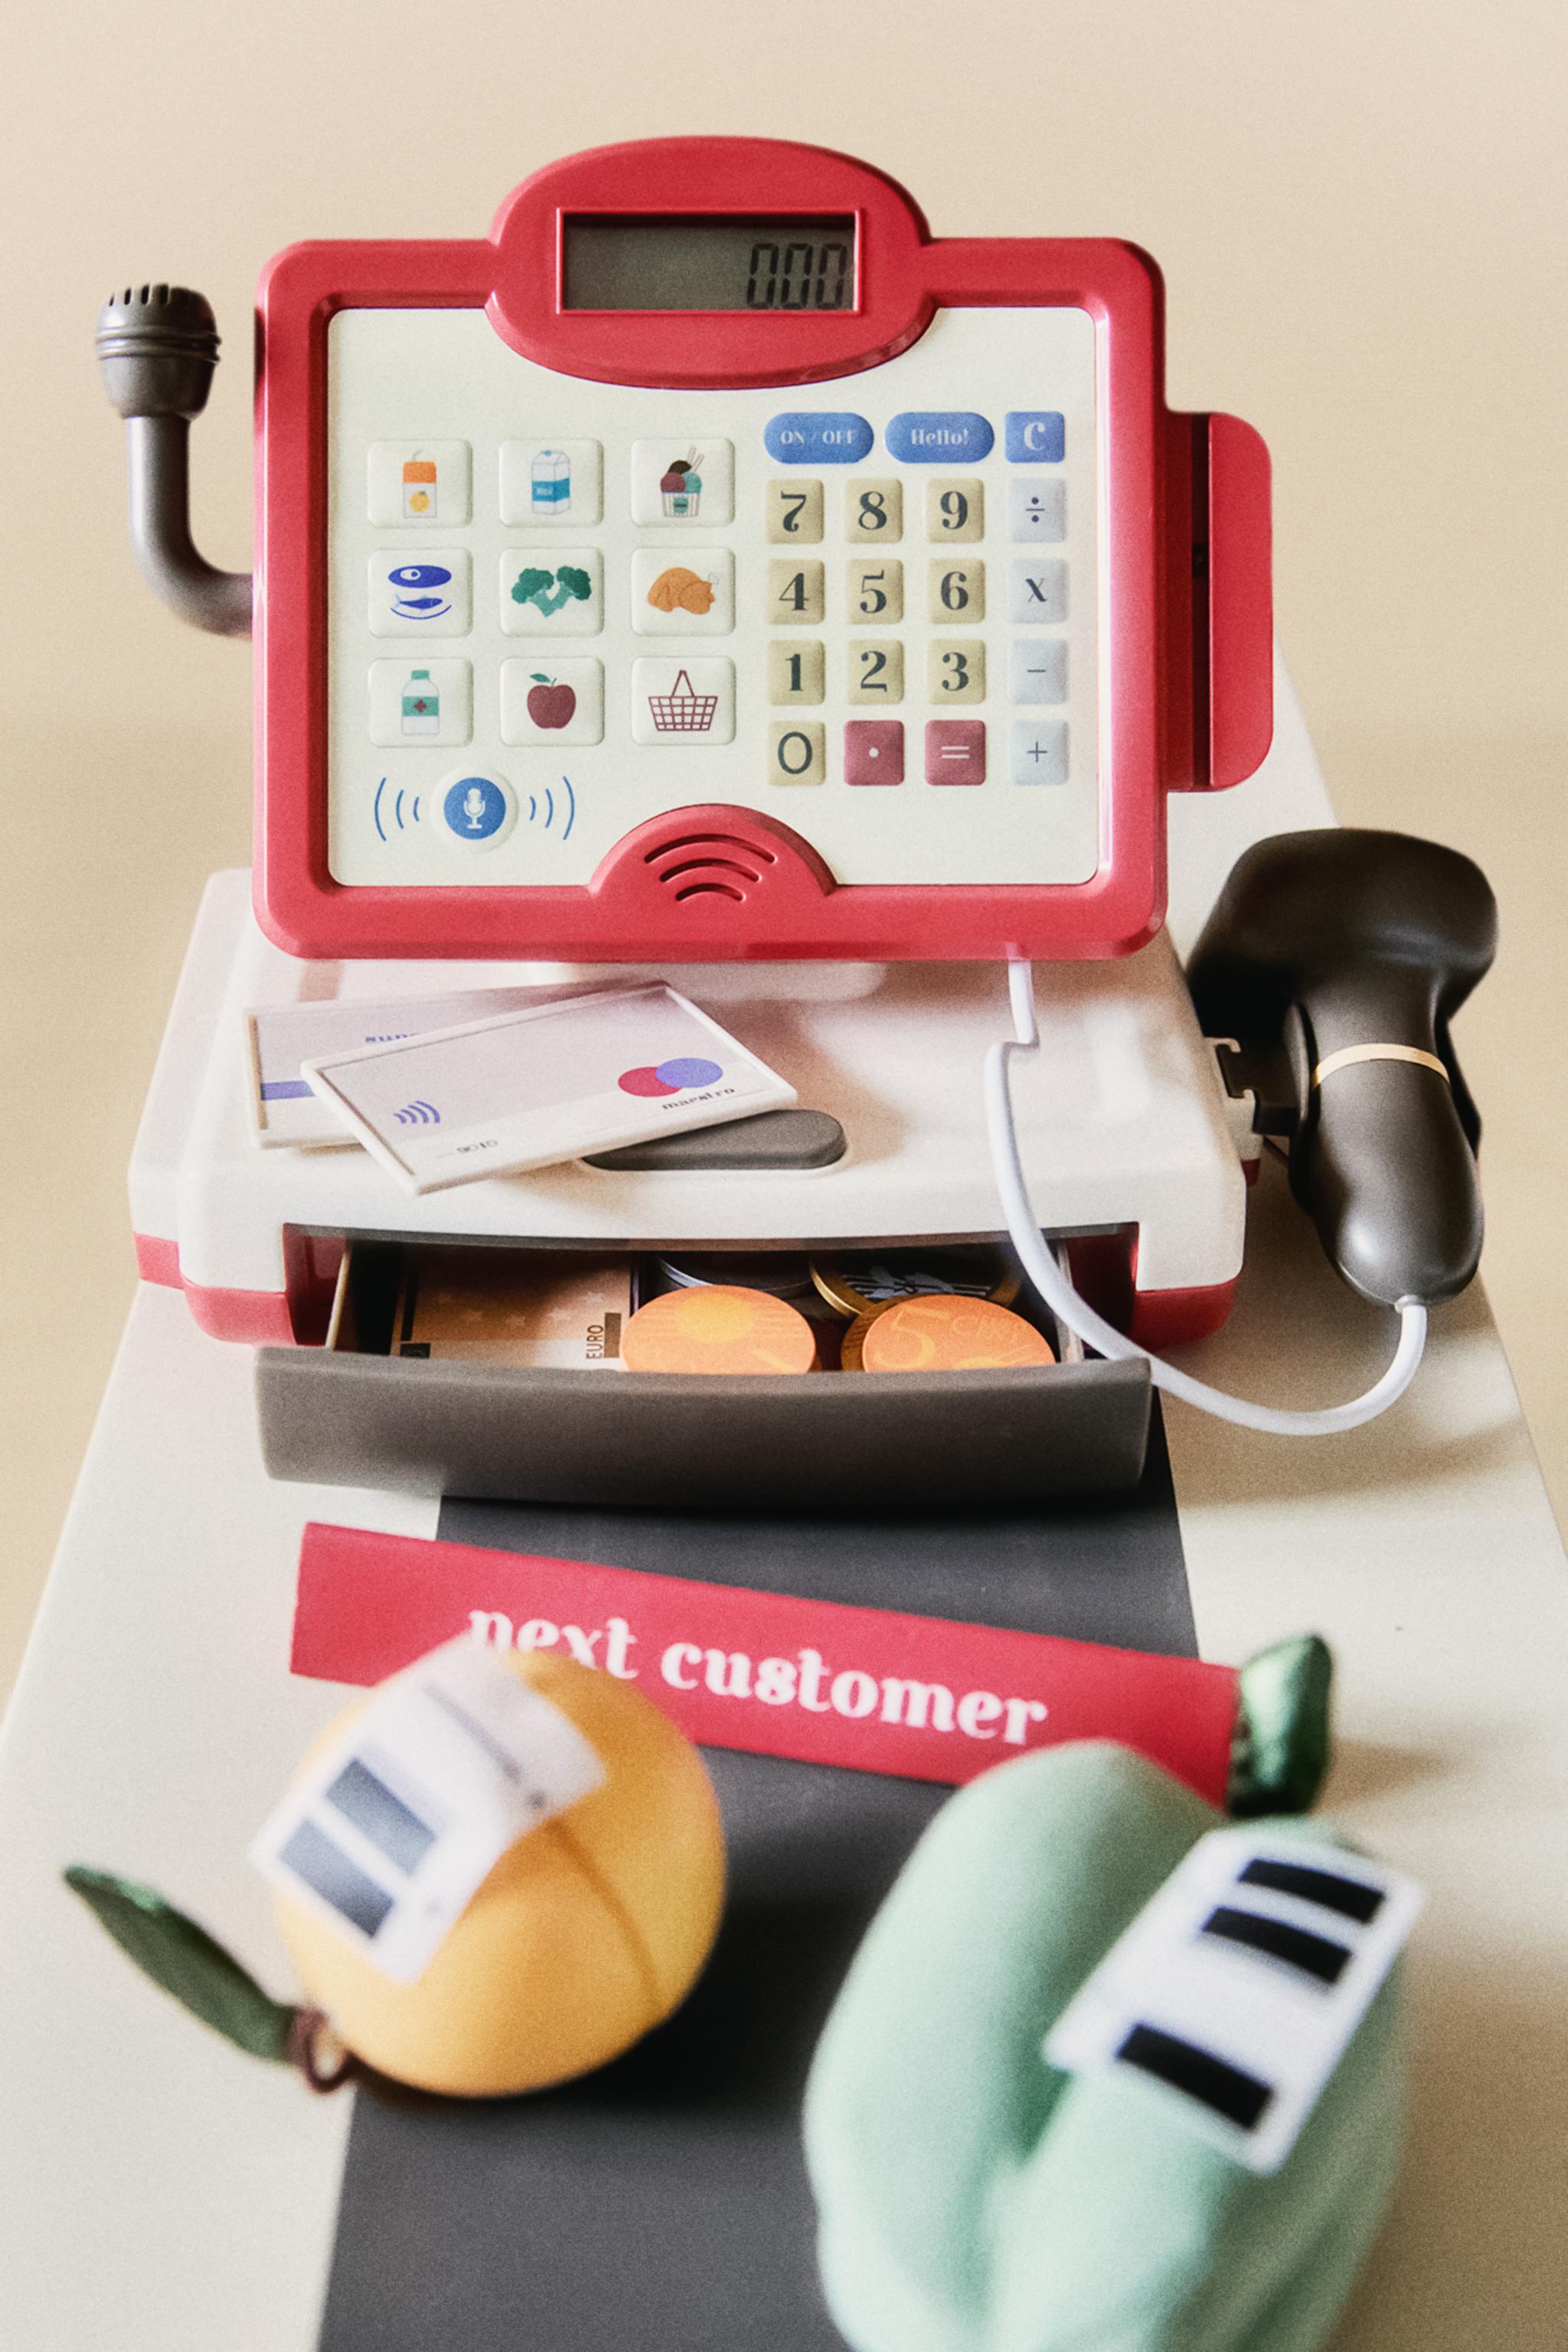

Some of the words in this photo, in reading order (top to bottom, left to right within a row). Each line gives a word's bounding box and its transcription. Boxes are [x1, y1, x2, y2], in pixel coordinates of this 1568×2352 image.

[780, 430, 805, 445] ON
[822, 429, 857, 445] OFF
[910, 426, 969, 446] Hello!
[1023, 421, 1047, 451] C
[779, 490, 808, 533] 7
[858, 490, 888, 531] 8
[939, 490, 969, 531] 9
[778, 572, 810, 612] 4
[859, 569, 888, 615] 5
[940, 570, 969, 611] 6
[785, 652, 804, 692] 1
[859, 650, 888, 693] 2
[941, 651, 970, 692] 3
[776, 731, 814, 776] 0
[585, 1324, 604, 1359] EURO
[873, 1303, 951, 1369] 5
[468, 1609, 639, 1680] next
[661, 1642, 1047, 1745] customer
